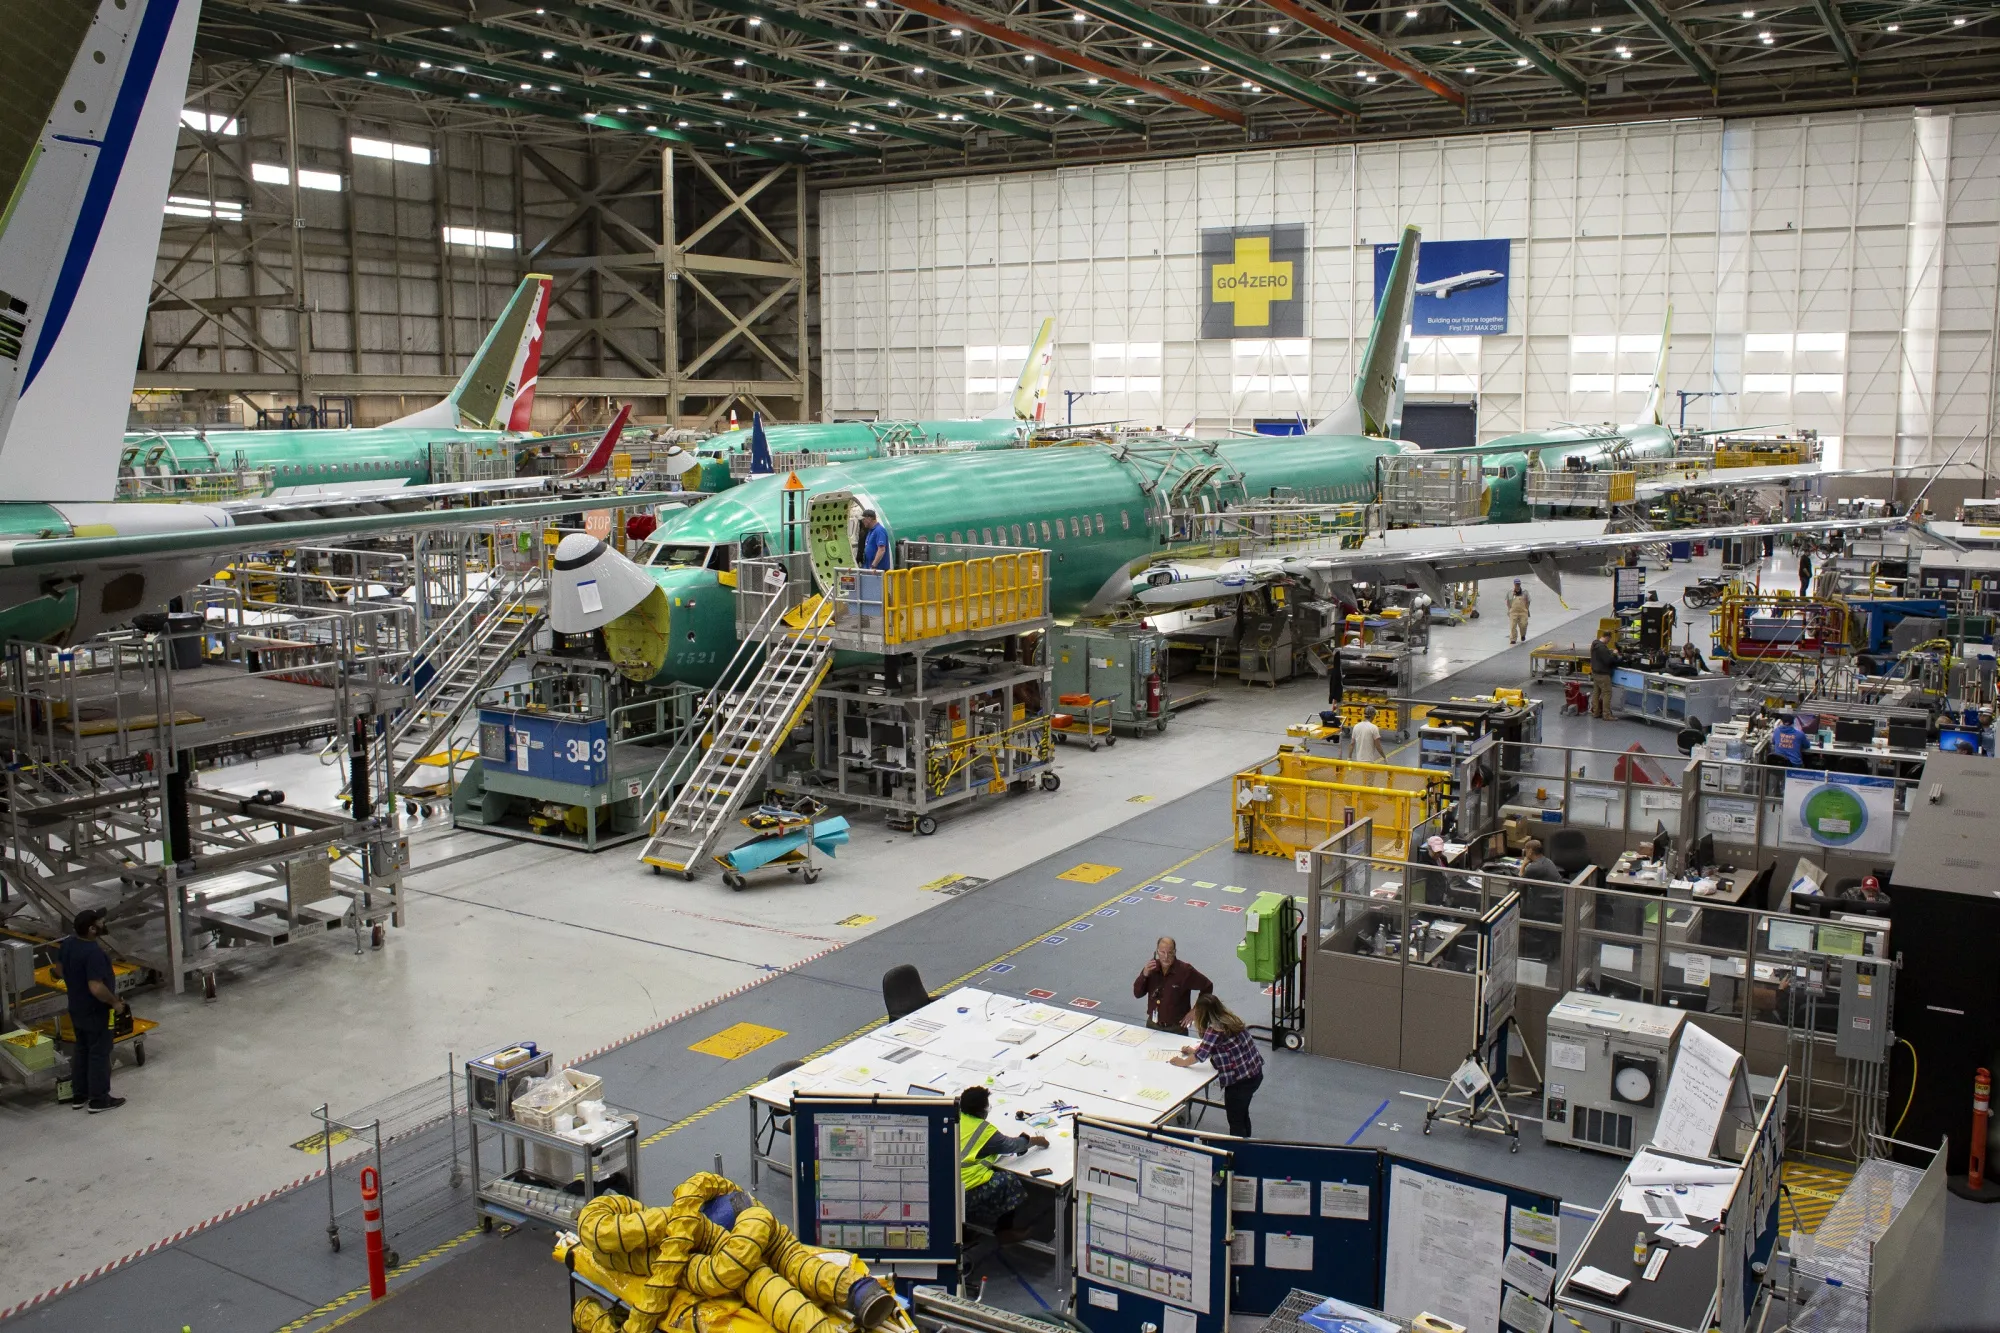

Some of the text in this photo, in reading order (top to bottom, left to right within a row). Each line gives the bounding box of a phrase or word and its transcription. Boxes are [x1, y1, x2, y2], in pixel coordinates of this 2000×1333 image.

[1786, 221, 1792, 229] K
[1217, 271, 1288, 289] GO4ZERO
[1427, 317, 1451, 325] Building
[1480, 316, 1504, 324] together
[587, 516, 611, 531] STOP
[676, 651, 716, 665] 7521
[566, 739, 579, 763] 3
[593, 738, 607, 763] 3
[1803, 1189, 1835, 1199] CLEAR
